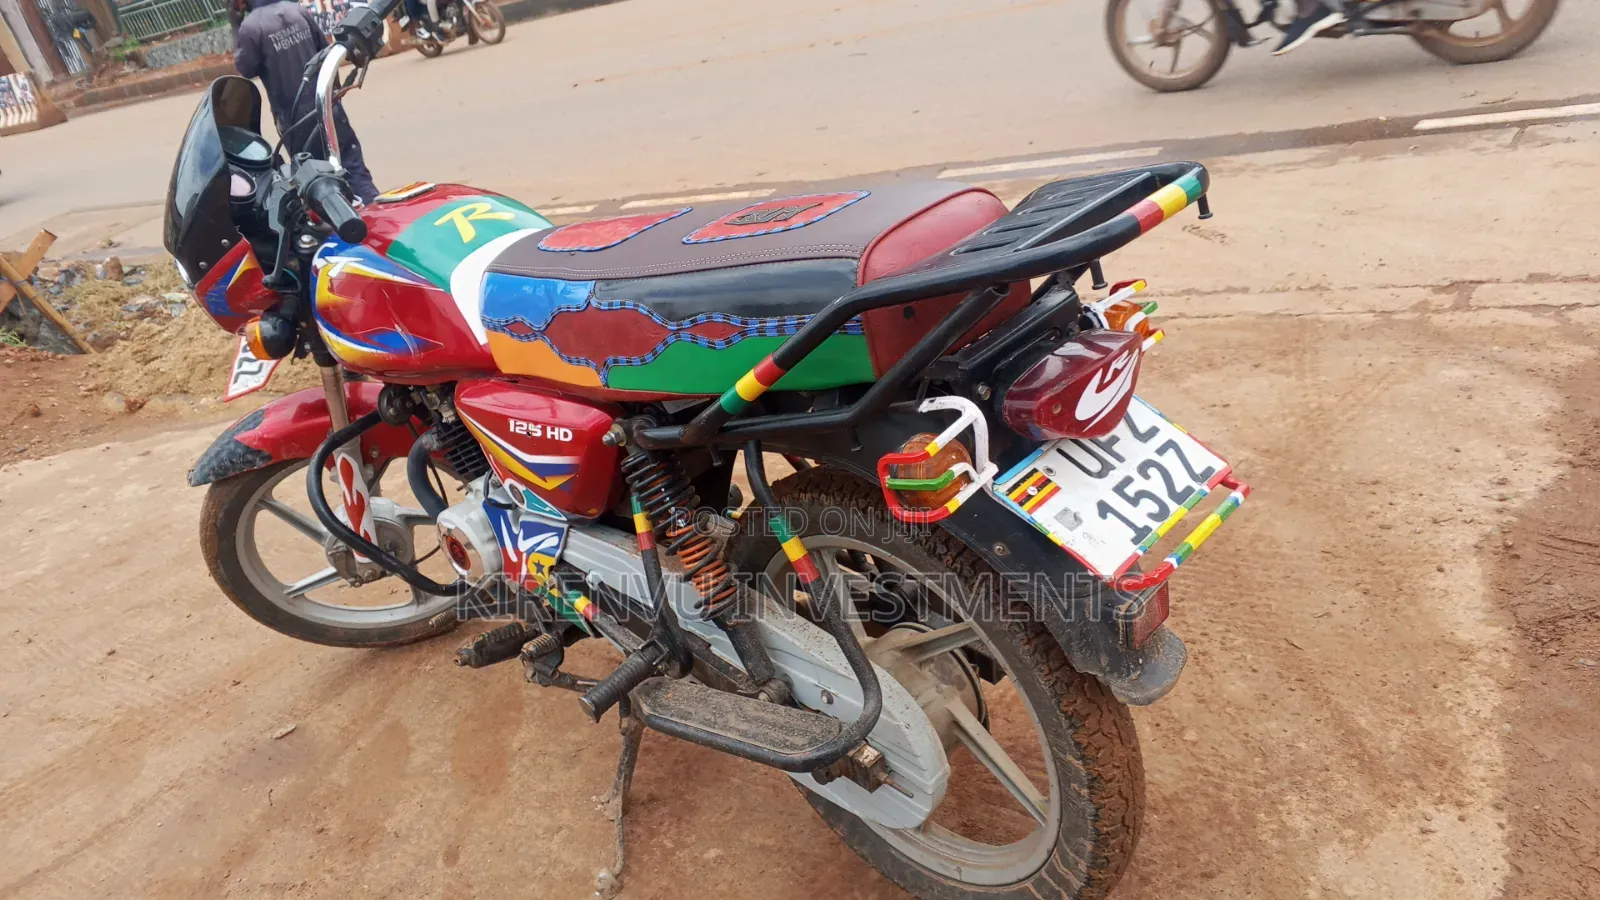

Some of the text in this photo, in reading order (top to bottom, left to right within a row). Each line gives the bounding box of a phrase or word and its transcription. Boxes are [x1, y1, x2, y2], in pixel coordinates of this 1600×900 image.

[508, 418, 573, 442] 125 HD
[1096, 438, 1216, 546] 152Z
